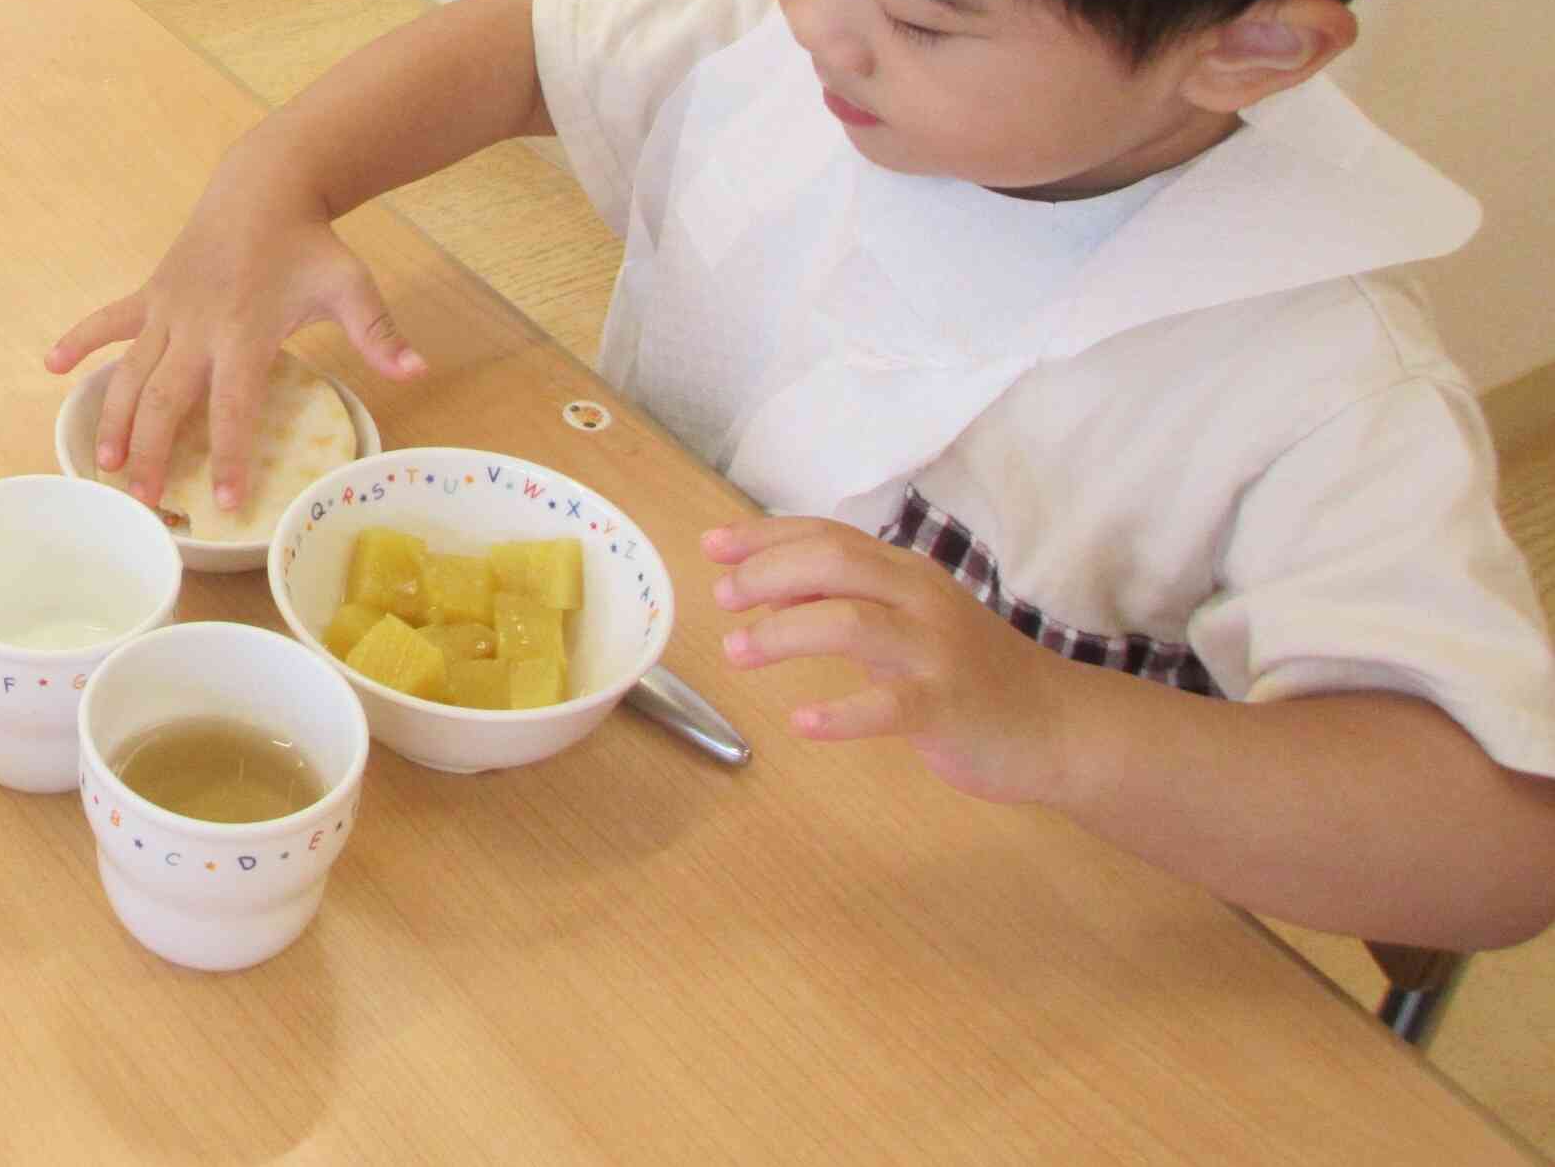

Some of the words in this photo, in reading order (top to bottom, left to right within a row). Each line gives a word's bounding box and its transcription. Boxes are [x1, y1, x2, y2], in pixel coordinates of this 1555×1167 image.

[311, 501, 326, 521] Q
[342, 486, 355, 505] R
[371, 483, 386, 501] S
[405, 467, 420, 485] T
[444, 476, 459, 495] U
[487, 466, 501, 483] V
[523, 477, 546, 499] W
[566, 499, 581, 519] X
[624, 540, 637, 560] Z
[3, 676, 17, 694] F
[165, 852, 181, 867] C
[237, 855, 257, 871] D
[308, 830, 324, 850] E
